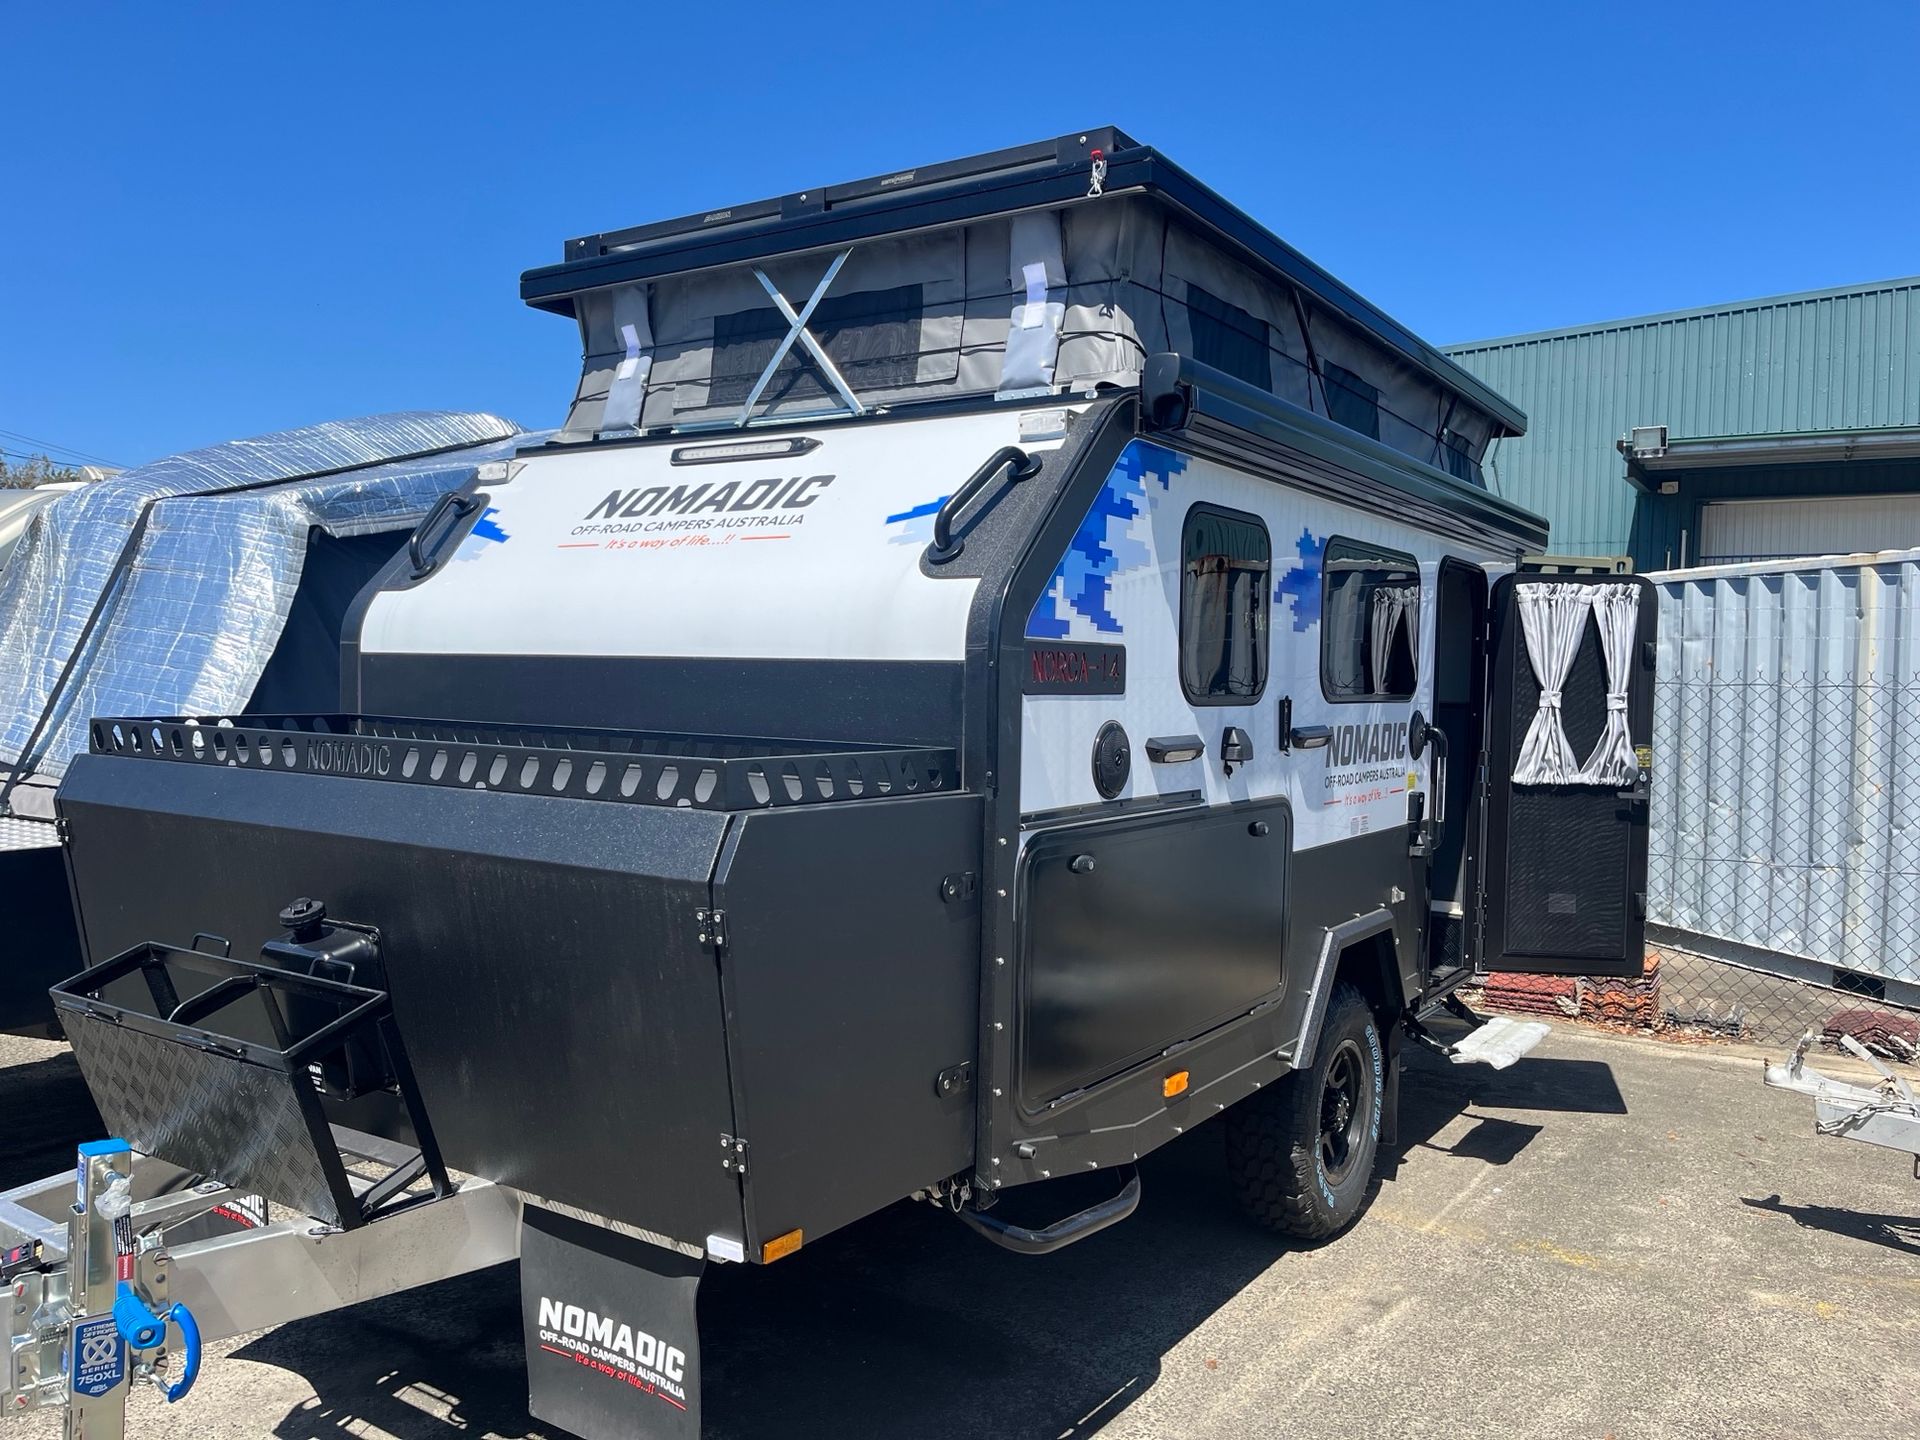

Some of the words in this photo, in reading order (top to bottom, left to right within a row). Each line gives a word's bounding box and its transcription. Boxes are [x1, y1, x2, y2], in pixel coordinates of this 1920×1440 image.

[584, 475, 836, 520] NOMADIC
[571, 522, 643, 536] OFF-ROAD
[644, 518, 715, 532] CAMPERS
[714, 514, 805, 528] AUSTRALIA
[605, 538, 626, 550] It's
[627, 540, 638, 549] a
[639, 540, 669, 551] way
[669, 535, 690, 548] of
[1032, 650, 1120, 685] NORCA-14
[307, 740, 390, 776] NOMADIC
[1325, 723, 1407, 768] NOMADIC
[1324, 773, 1355, 789] OFF-ROAD
[1355, 769, 1379, 785] CAMPERS
[1379, 767, 1405, 780] AUSTRALIA
[83, 1321, 117, 1334] EXTREME
[83, 1327, 117, 1338] OFFROAD
[538, 1297, 686, 1382] NOMADIC
[81, 1362, 116, 1375] SERIES
[540, 1329, 590, 1354] OFF-ROAD
[591, 1346, 635, 1373] CAMPERS
[637, 1366, 685, 1400] AUSTRALIA
[575, 1353, 590, 1366] It's
[590, 1360, 597, 1369] a
[598, 1363, 616, 1379] way
[617, 1371, 627, 1382] of
[77, 1369, 121, 1386] 750XL
